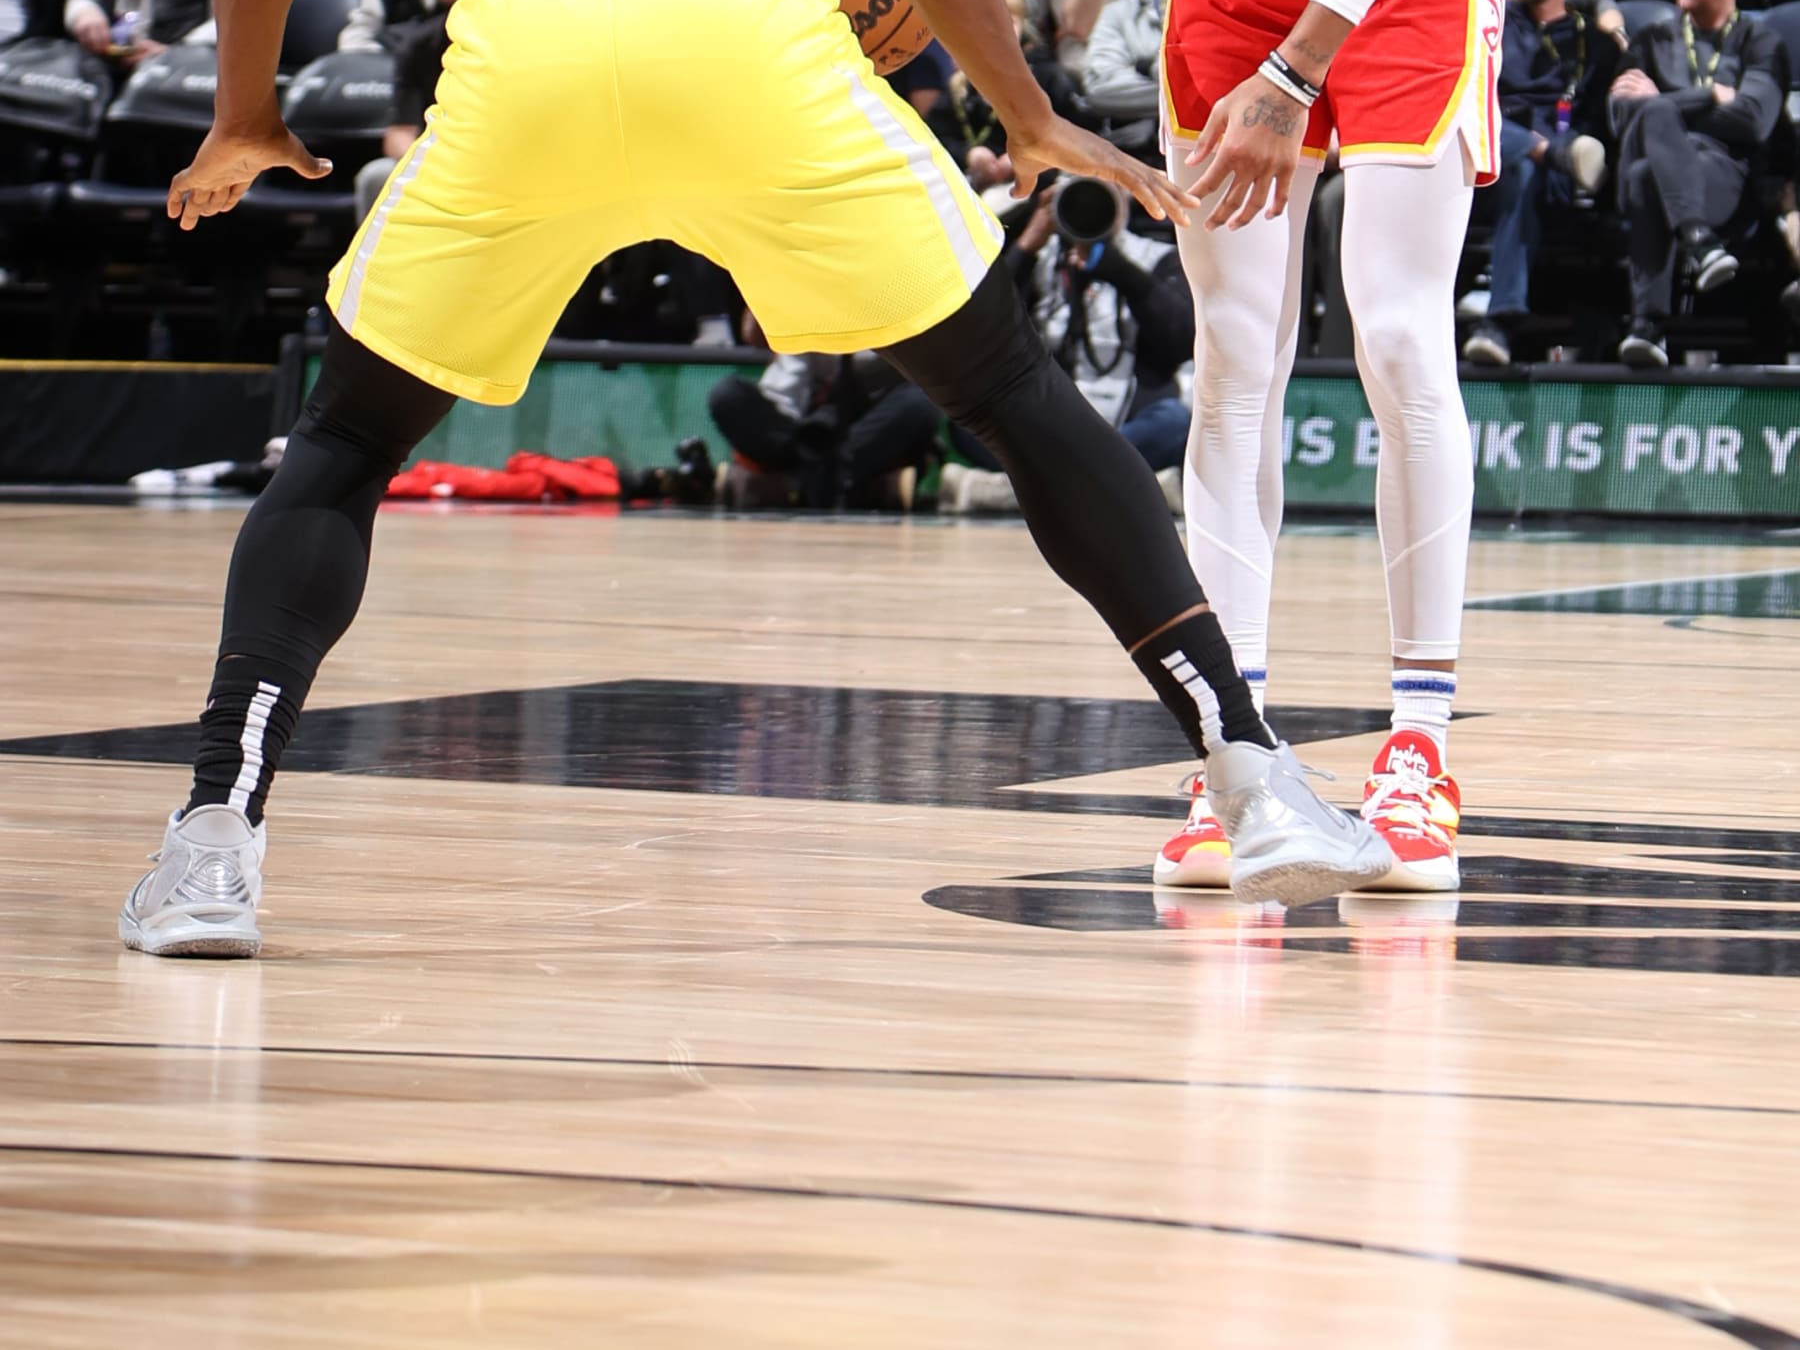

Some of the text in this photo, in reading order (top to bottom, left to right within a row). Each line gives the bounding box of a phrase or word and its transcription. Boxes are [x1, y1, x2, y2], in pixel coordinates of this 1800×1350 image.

[1545, 421, 1604, 471] IS
[1622, 423, 1742, 475] FOR
[1762, 426, 1800, 476] Y
